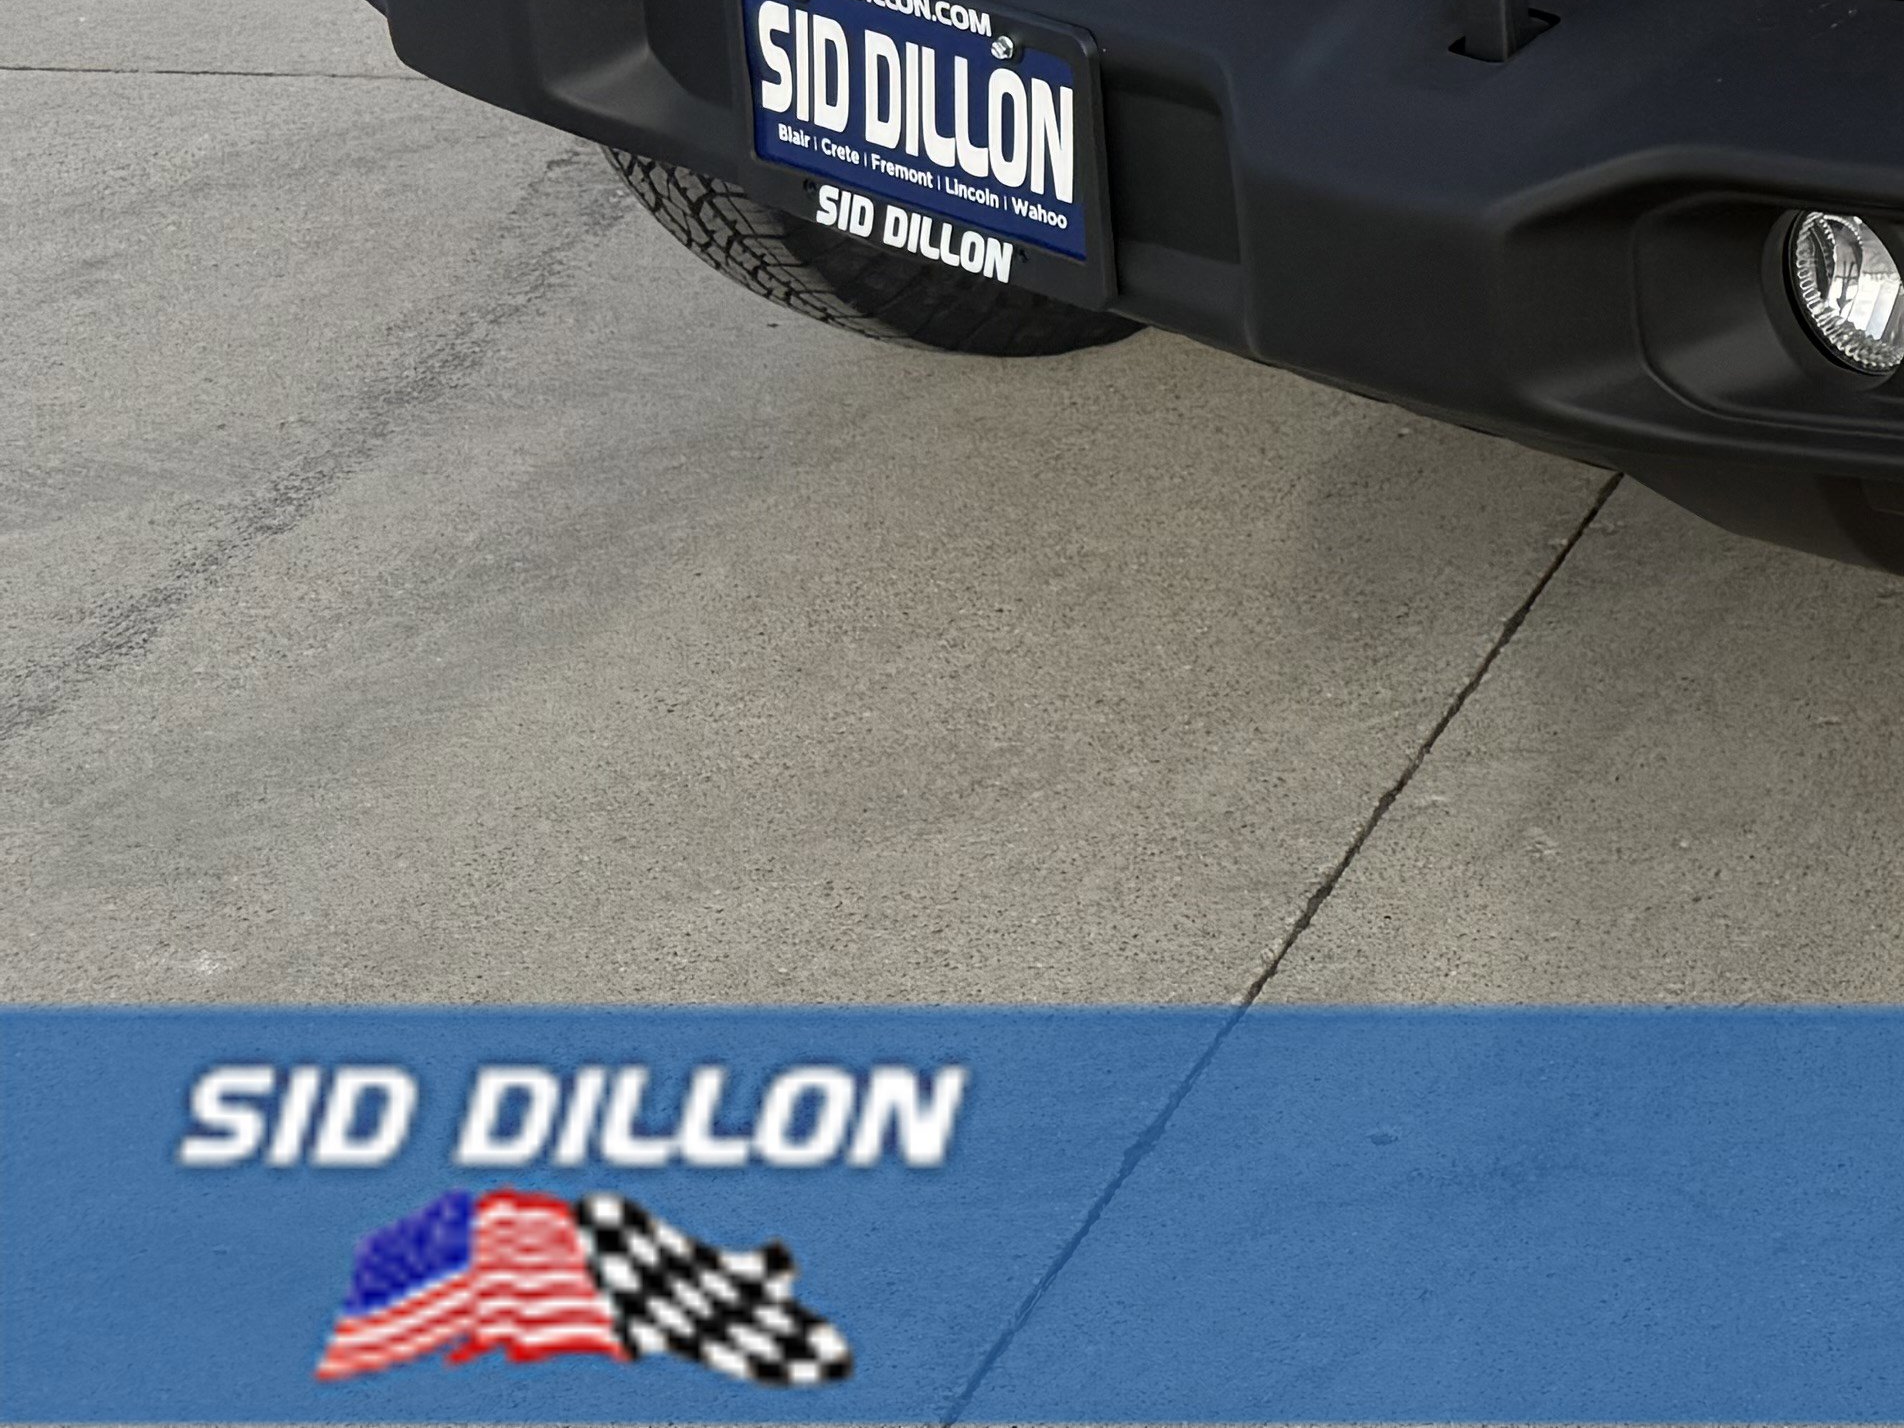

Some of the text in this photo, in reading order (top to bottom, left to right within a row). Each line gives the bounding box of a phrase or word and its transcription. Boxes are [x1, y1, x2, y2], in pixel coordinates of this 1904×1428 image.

[758, 0, 1074, 205] SID DILLON
[778, 123, 1068, 230] Blair Crete Fremont Lincoln Wahoo
[816, 184, 1014, 284] SID DILLON
